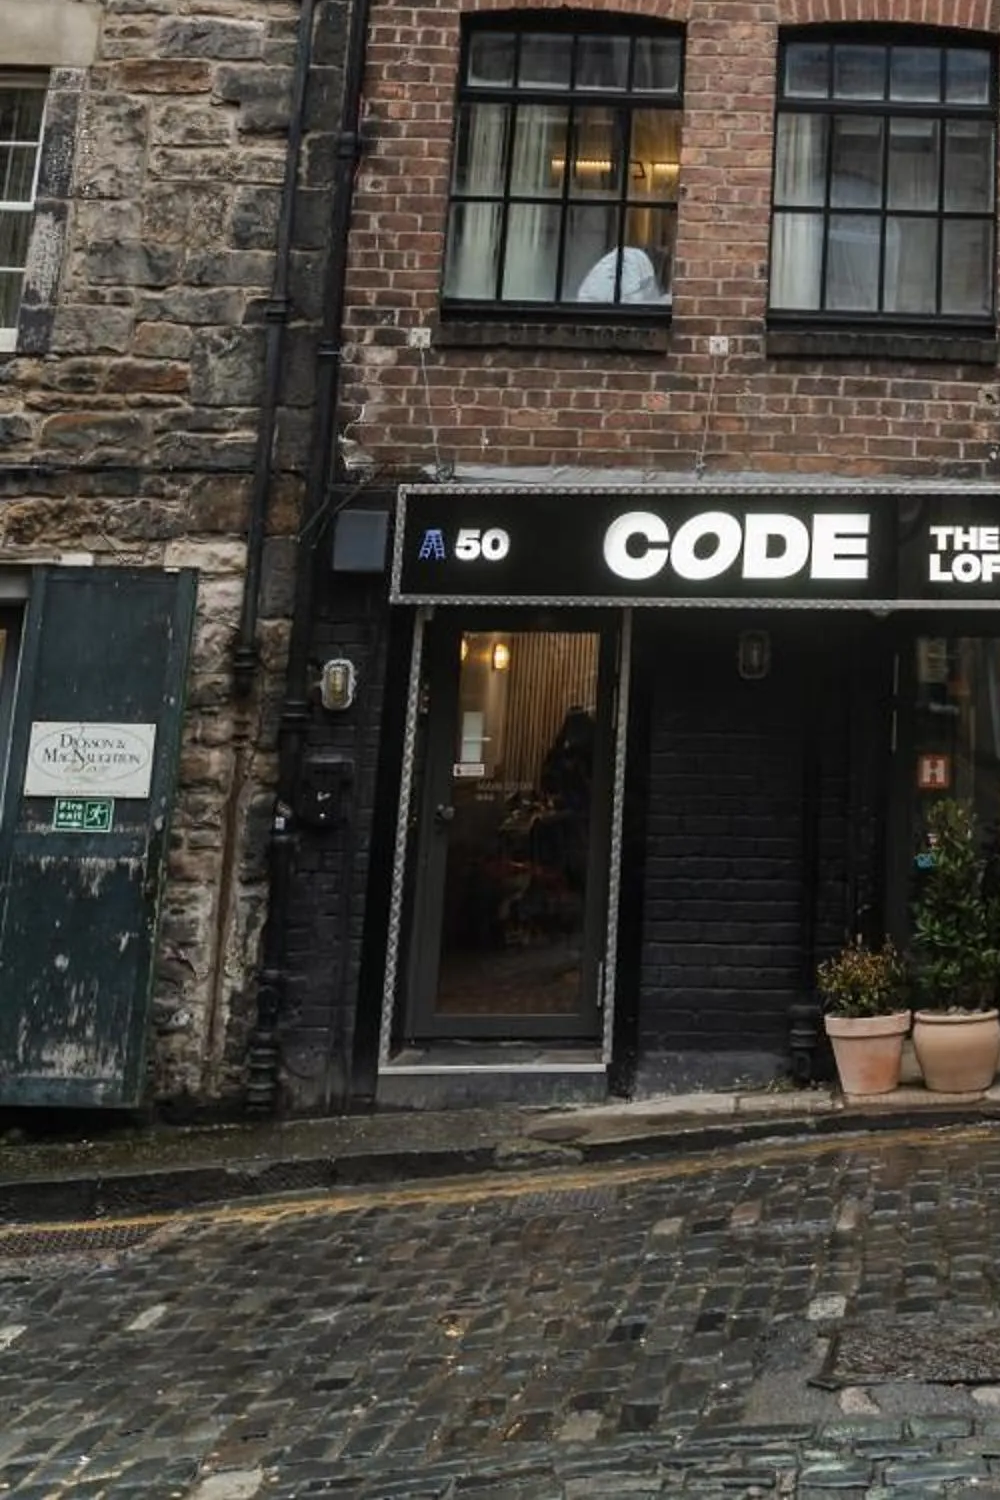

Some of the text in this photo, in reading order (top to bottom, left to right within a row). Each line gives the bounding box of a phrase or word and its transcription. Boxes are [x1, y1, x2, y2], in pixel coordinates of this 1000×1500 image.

[455, 511, 871, 580] 50 CODE
[929, 525, 1000, 551] THE
